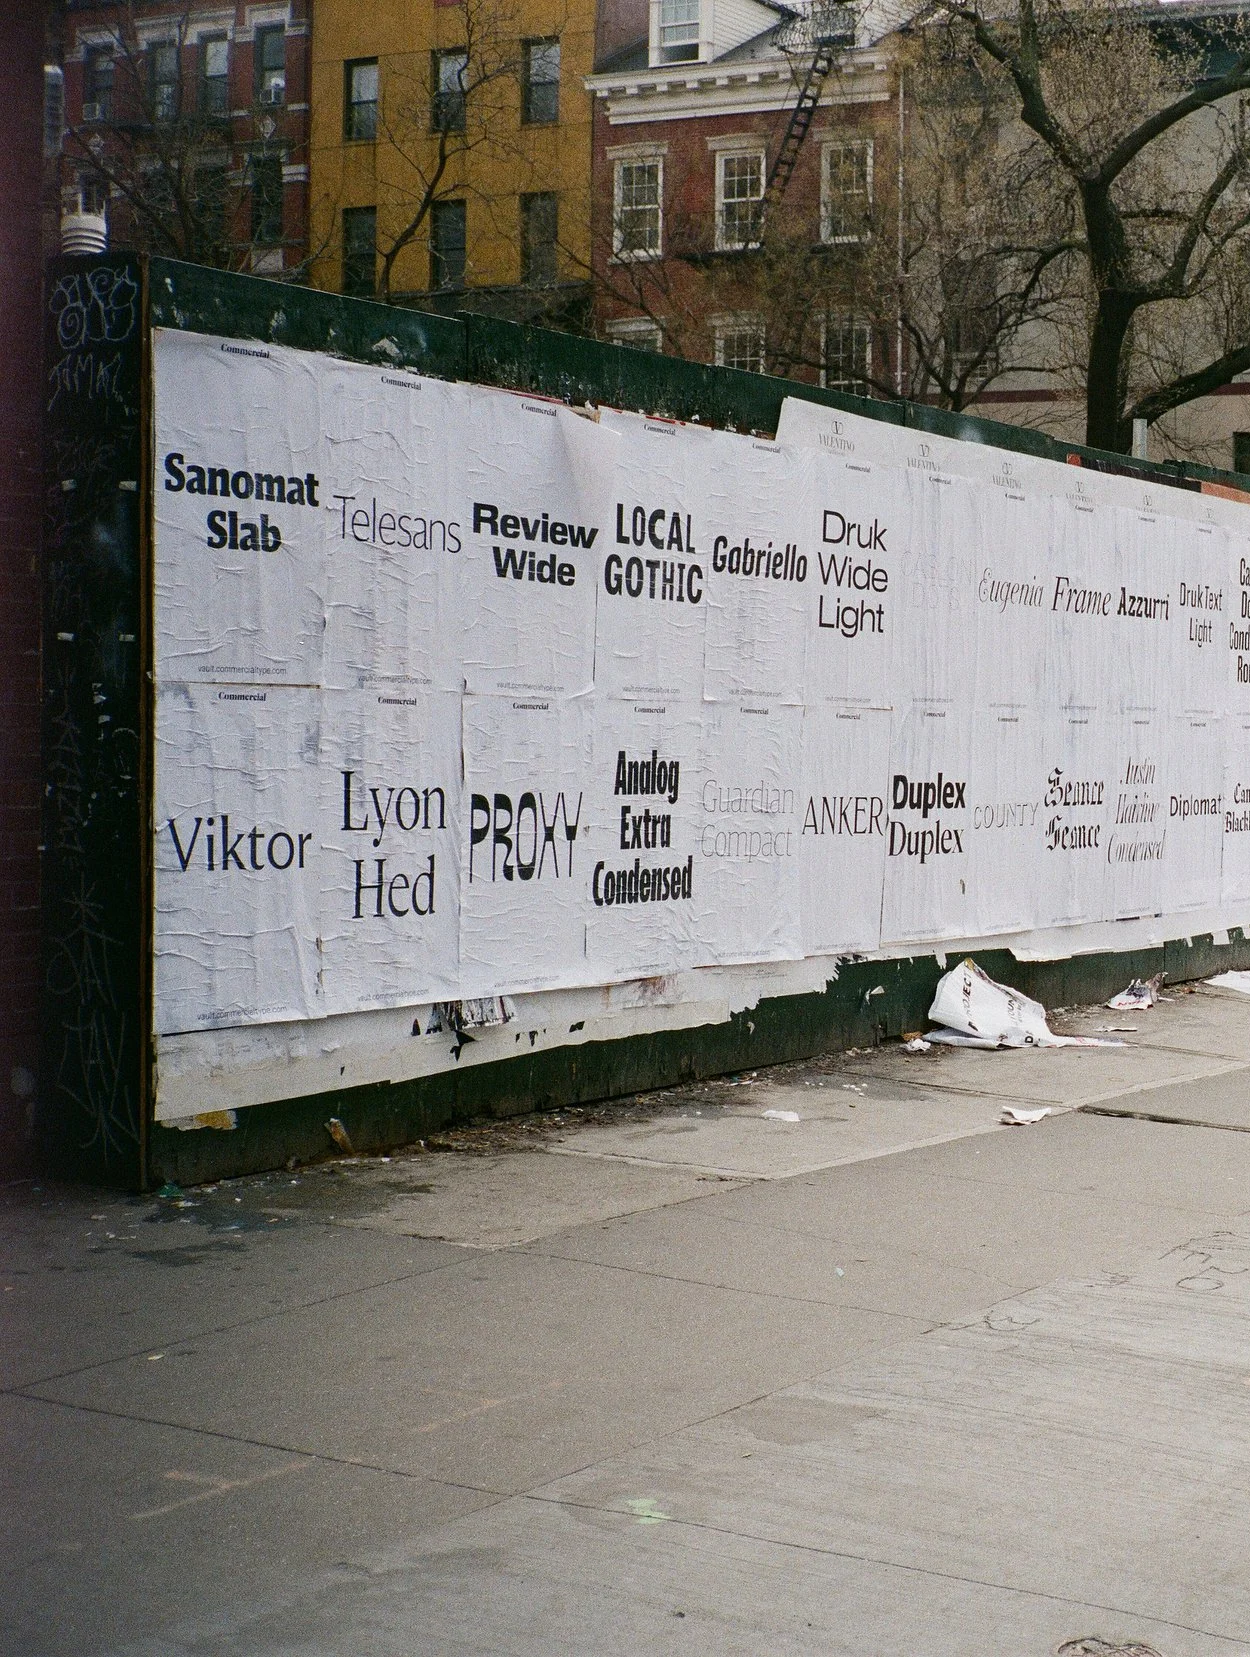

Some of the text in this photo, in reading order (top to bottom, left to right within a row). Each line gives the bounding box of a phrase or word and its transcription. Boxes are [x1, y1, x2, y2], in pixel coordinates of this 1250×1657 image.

[220, 343, 270, 359] Commercial
[380, 375, 422, 391] Commercial
[520, 402, 557, 417] Commercial
[643, 423, 676, 436] Commercial
[752, 442, 781, 454] Commercial
[164, 452, 319, 507] Sanomat
[206, 510, 283, 553] Slab
[333, 494, 462, 554] Telesans
[472, 502, 599, 549] Review
[616, 503, 696, 554] LOCAL
[823, 509, 887, 552] Druk
[493, 546, 576, 586] Wide
[712, 535, 808, 582] Gabriello
[817, 552, 888, 593] Wide
[604, 554, 703, 604] GOTHIC
[978, 567, 1044, 614] Eugenia
[1051, 575, 1112, 617] Frame
[1180, 582, 1222, 611] Druk Text
[818, 595, 884, 638] Light
[1116, 587, 1170, 621] Azzurri
[1189, 617, 1212, 648] Light
[197, 664, 287, 676] vault.commercialtype.com
[358, 673, 433, 685] vault.commercialtype.com
[218, 690, 267, 702] Commercial
[377, 695, 417, 706] Commercial
[512, 702, 549, 711] Commercial
[634, 706, 666, 715] Commercial
[740, 706, 769, 715] Commercial
[614, 750, 680, 804] Analog
[701, 778, 794, 814] Guardian
[892, 772, 967, 818] Duplex
[1044, 767, 1105, 808] Seance
[341, 771, 446, 846] Lyon
[620, 805, 671, 850] Extra
[801, 796, 884, 836] ANKER
[973, 802, 1039, 830] COUNTY
[1169, 795, 1223, 821] Diplomat
[168, 816, 312, 871] Viktor
[470, 791, 582, 883] PROXY
[701, 824, 793, 863] Compact
[888, 820, 964, 864] Duplex
[352, 854, 436, 919] Hed
[592, 855, 693, 907] Condensed
[197, 1004, 288, 1022] vault.commercialtype.com
